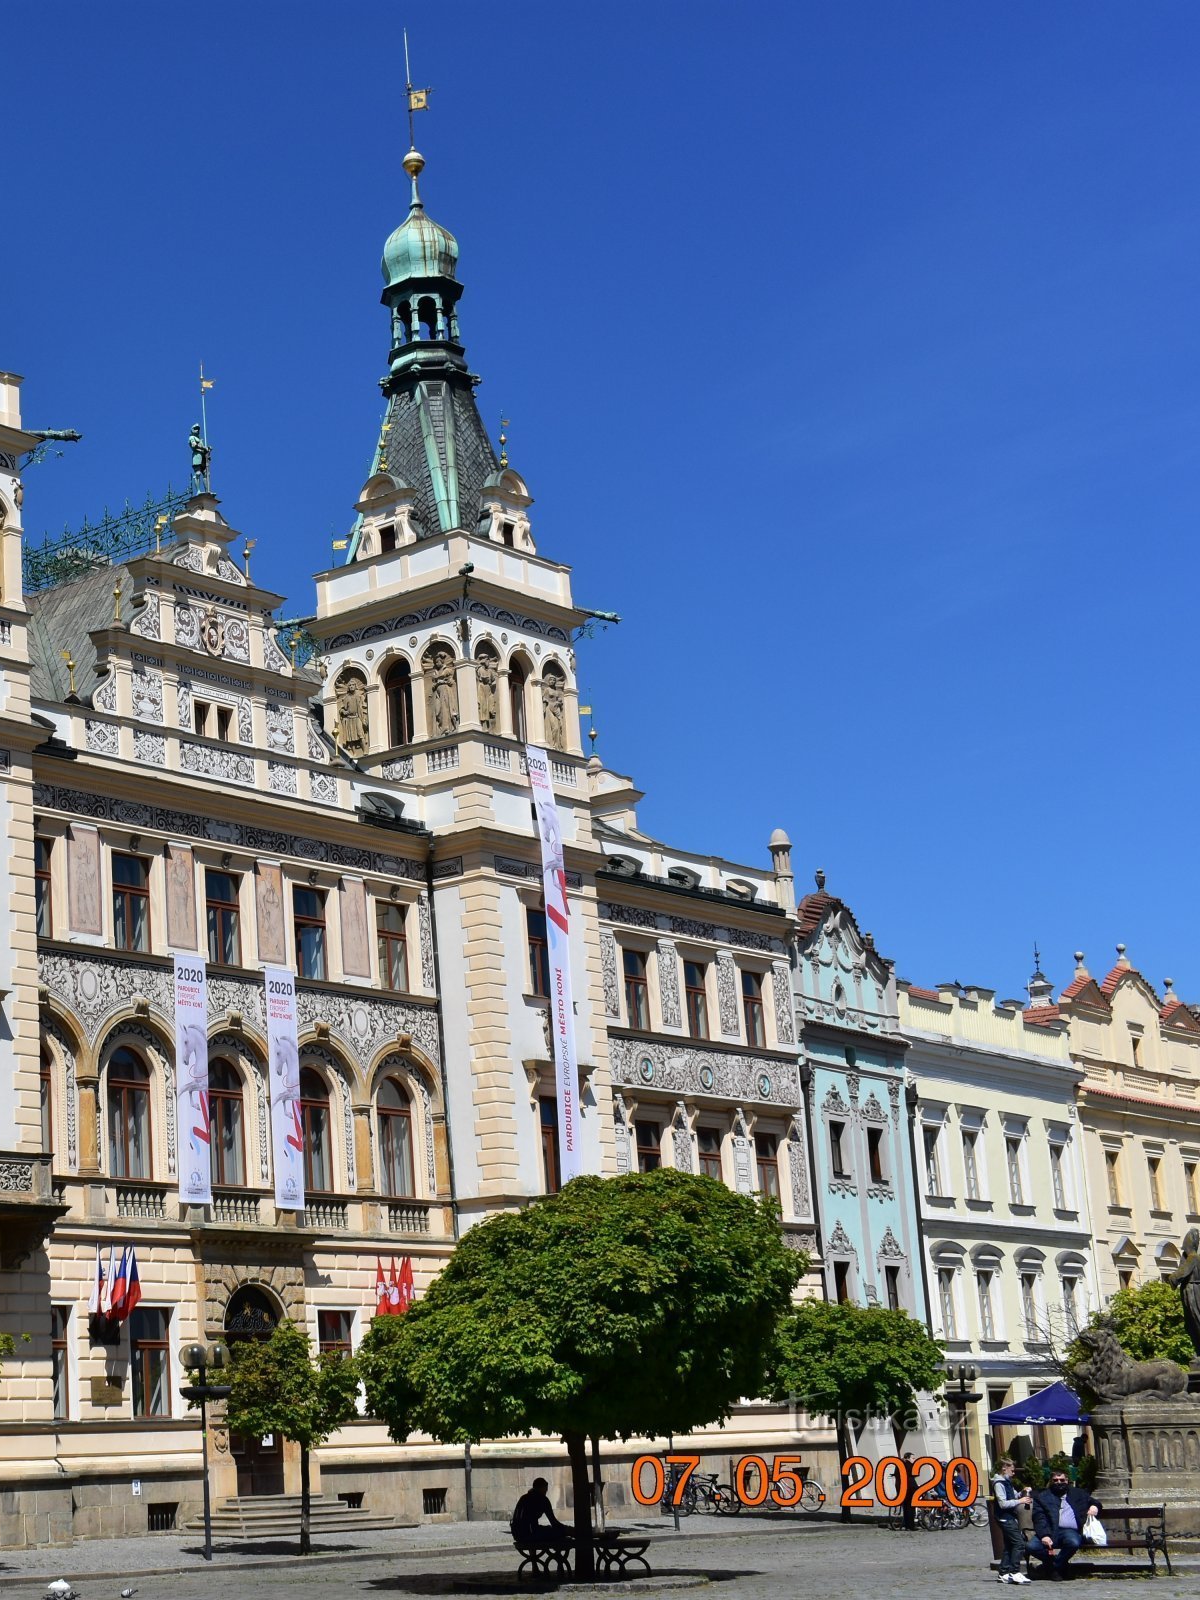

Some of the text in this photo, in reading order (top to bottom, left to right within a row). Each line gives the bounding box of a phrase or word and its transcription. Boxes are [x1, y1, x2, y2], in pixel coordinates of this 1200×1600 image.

[528, 757, 547, 772] 2020
[177, 967, 203, 983] 2020
[269, 980, 292, 996] 2020
[555, 967, 573, 1152] PARDUBICE EVROPSKÉ MĚSTO KONÍ
